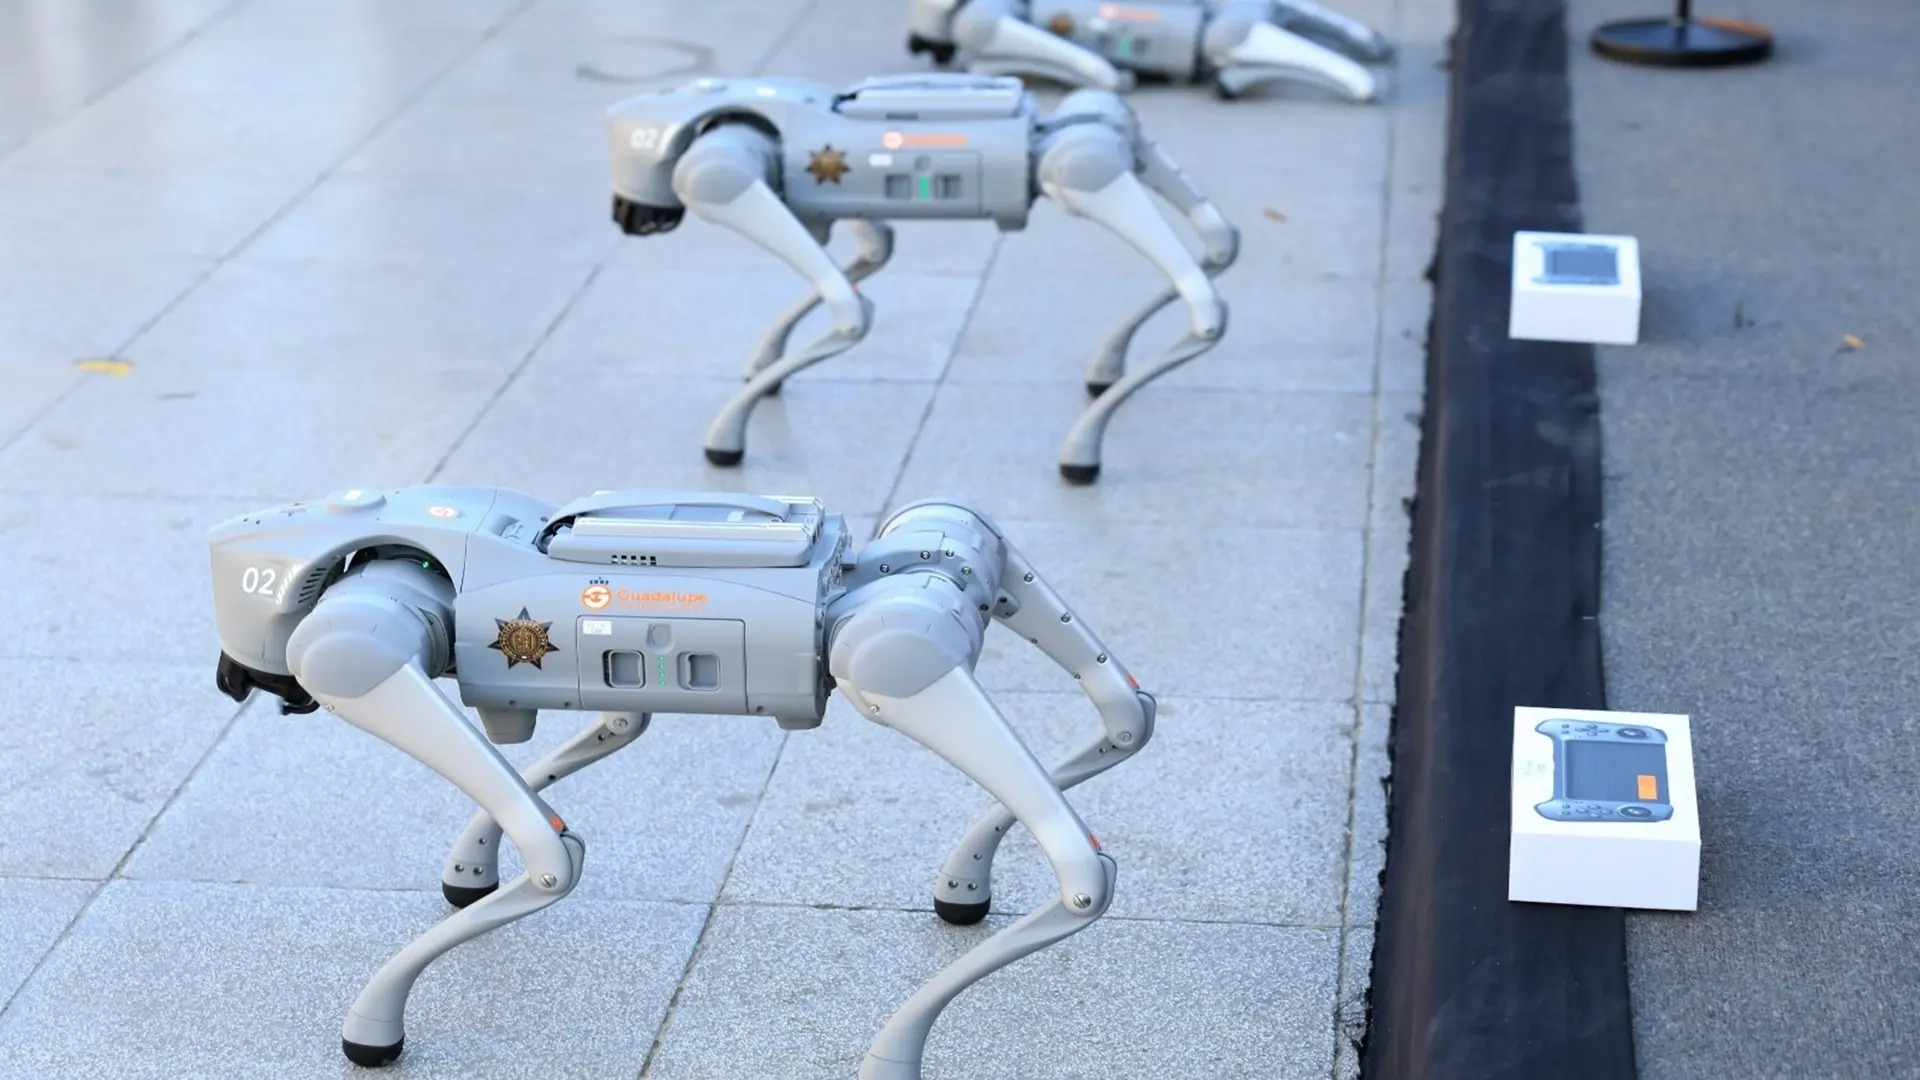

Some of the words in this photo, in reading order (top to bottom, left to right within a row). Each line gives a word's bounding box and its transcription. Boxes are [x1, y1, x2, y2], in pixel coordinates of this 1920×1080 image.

[631, 128, 658, 149] 02
[243, 567, 275, 594] 02
[617, 589, 708, 604] Guadalupe
